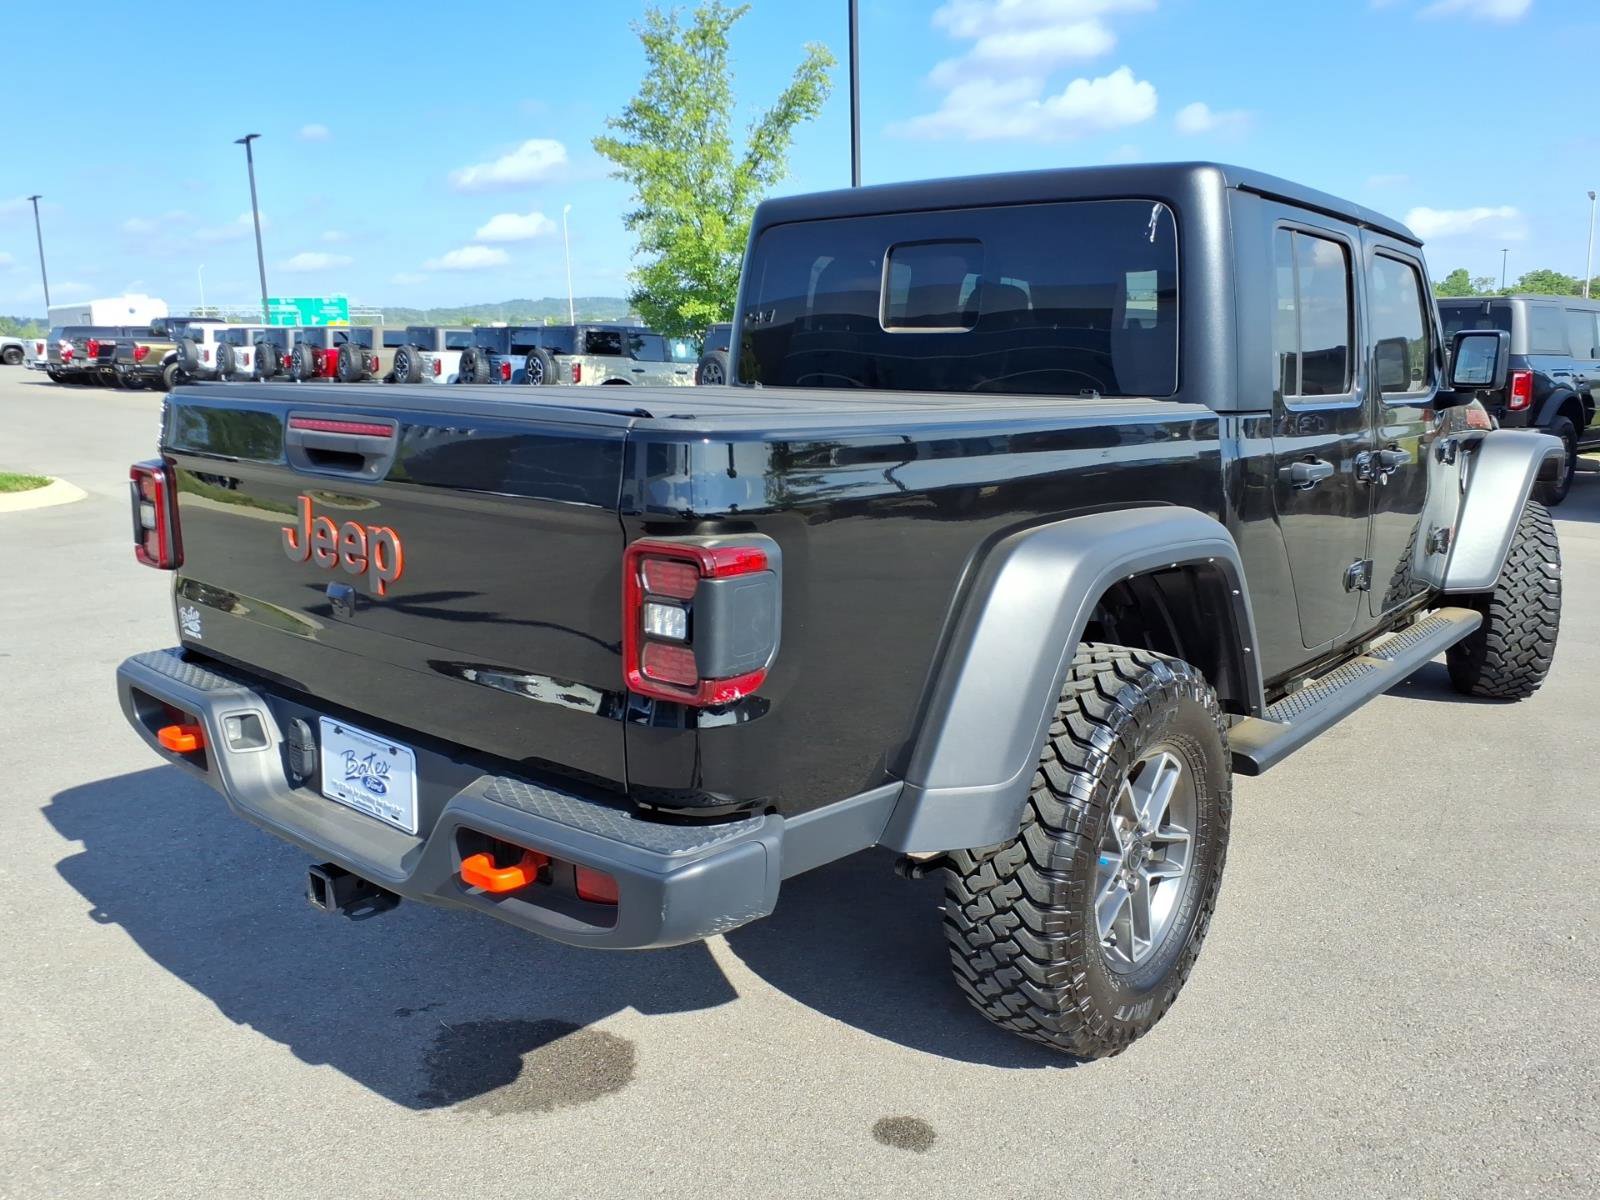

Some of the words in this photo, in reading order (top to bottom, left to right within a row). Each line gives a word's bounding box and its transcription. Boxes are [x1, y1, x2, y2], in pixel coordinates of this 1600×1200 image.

[281, 495, 405, 597] Jeep
[341, 749, 391, 776] Bates
[365, 777, 384, 793] Ford
